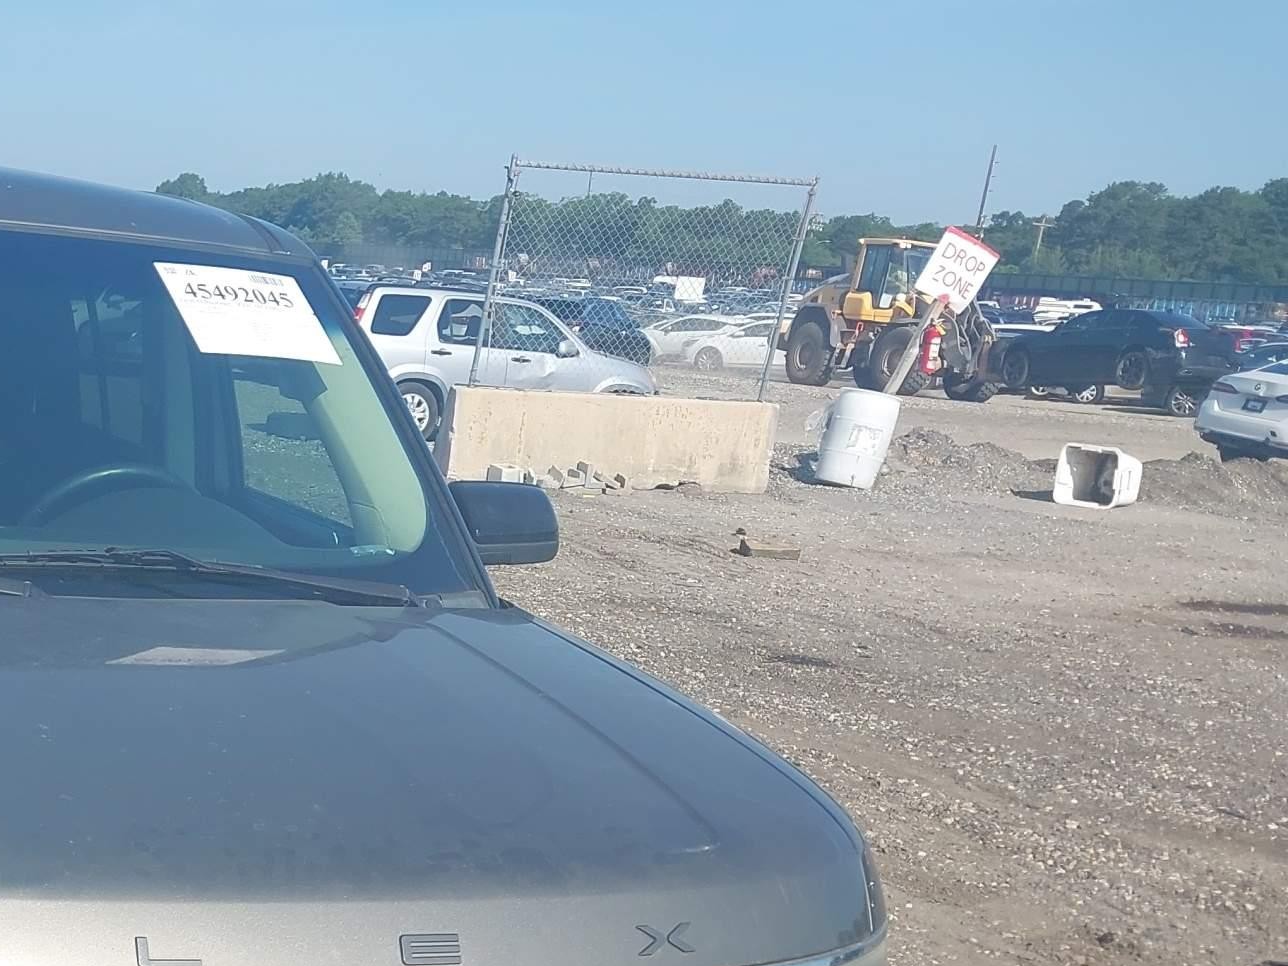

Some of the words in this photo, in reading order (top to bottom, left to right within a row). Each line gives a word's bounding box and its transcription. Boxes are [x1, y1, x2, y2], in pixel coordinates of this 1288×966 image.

[942, 242, 986, 276] DROP
[184, 282, 294, 308] 45492045
[932, 265, 974, 300] ZONE
